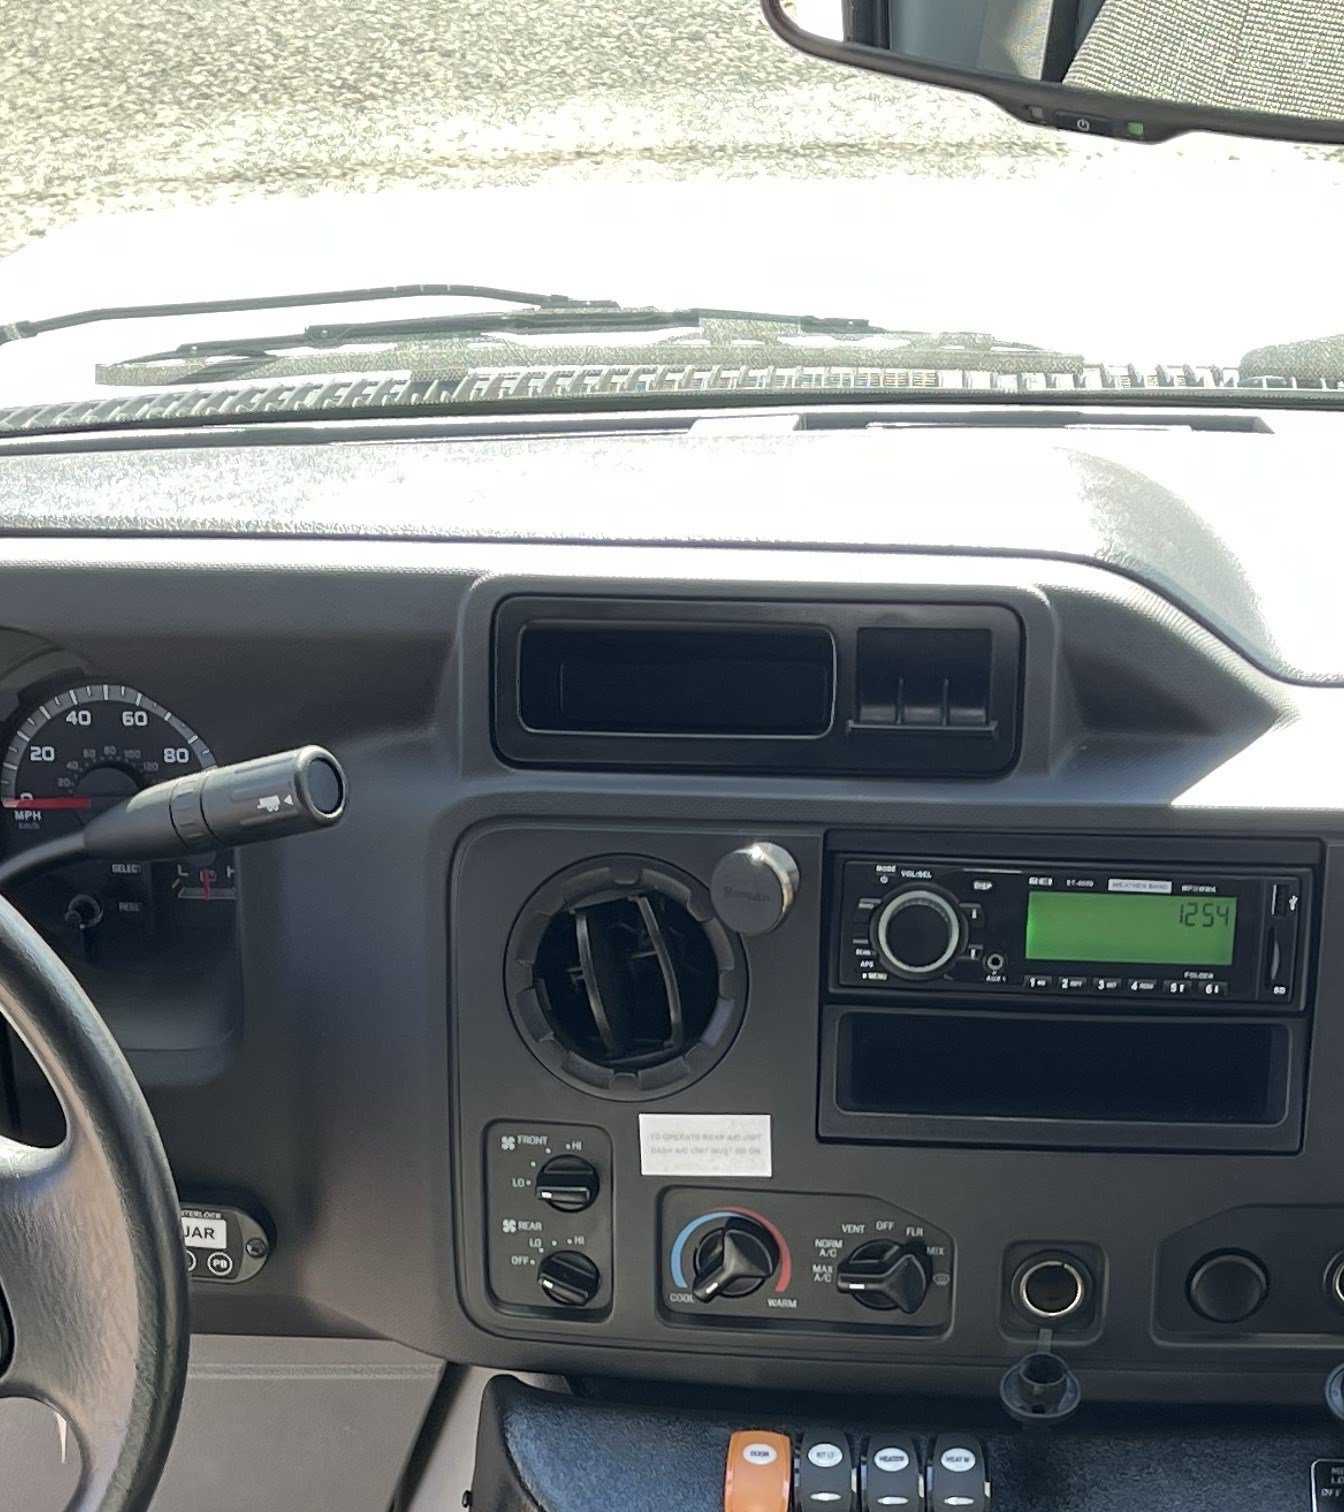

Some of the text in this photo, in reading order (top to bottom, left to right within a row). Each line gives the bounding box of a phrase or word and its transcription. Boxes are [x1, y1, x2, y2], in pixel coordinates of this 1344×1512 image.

[65, 710, 92, 726] 40
[122, 710, 148, 727] 60
[30, 746, 55, 762] 20
[163, 748, 190, 763] 80
[14, 810, 42, 821] MPH
[177, 864, 189, 877] L
[1029, 977, 1036, 988] 1
[1130, 980, 1138, 991] 4
[517, 1134, 548, 1145] FRONT
[572, 1141, 582, 1150] HI
[512, 1178, 525, 1188] LO
[517, 1221, 543, 1231] REAR
[841, 1223, 866, 1234] VENT
[875, 1221, 895, 1231] OFF
[184, 1225, 216, 1239] JAR
[906, 1226, 924, 1237] FLR
[529, 1238, 542, 1248] LO
[574, 1236, 585, 1245] HI
[814, 1239, 843, 1249] NORM
[819, 1249, 837, 1258] A/C
[926, 1246, 944, 1256] MIX
[511, 1255, 529, 1265] OFF
[812, 1264, 833, 1274] MAX
[813, 1273, 832, 1283] A/C
[669, 1293, 694, 1303] COOL
[767, 1298, 797, 1308] WARM
